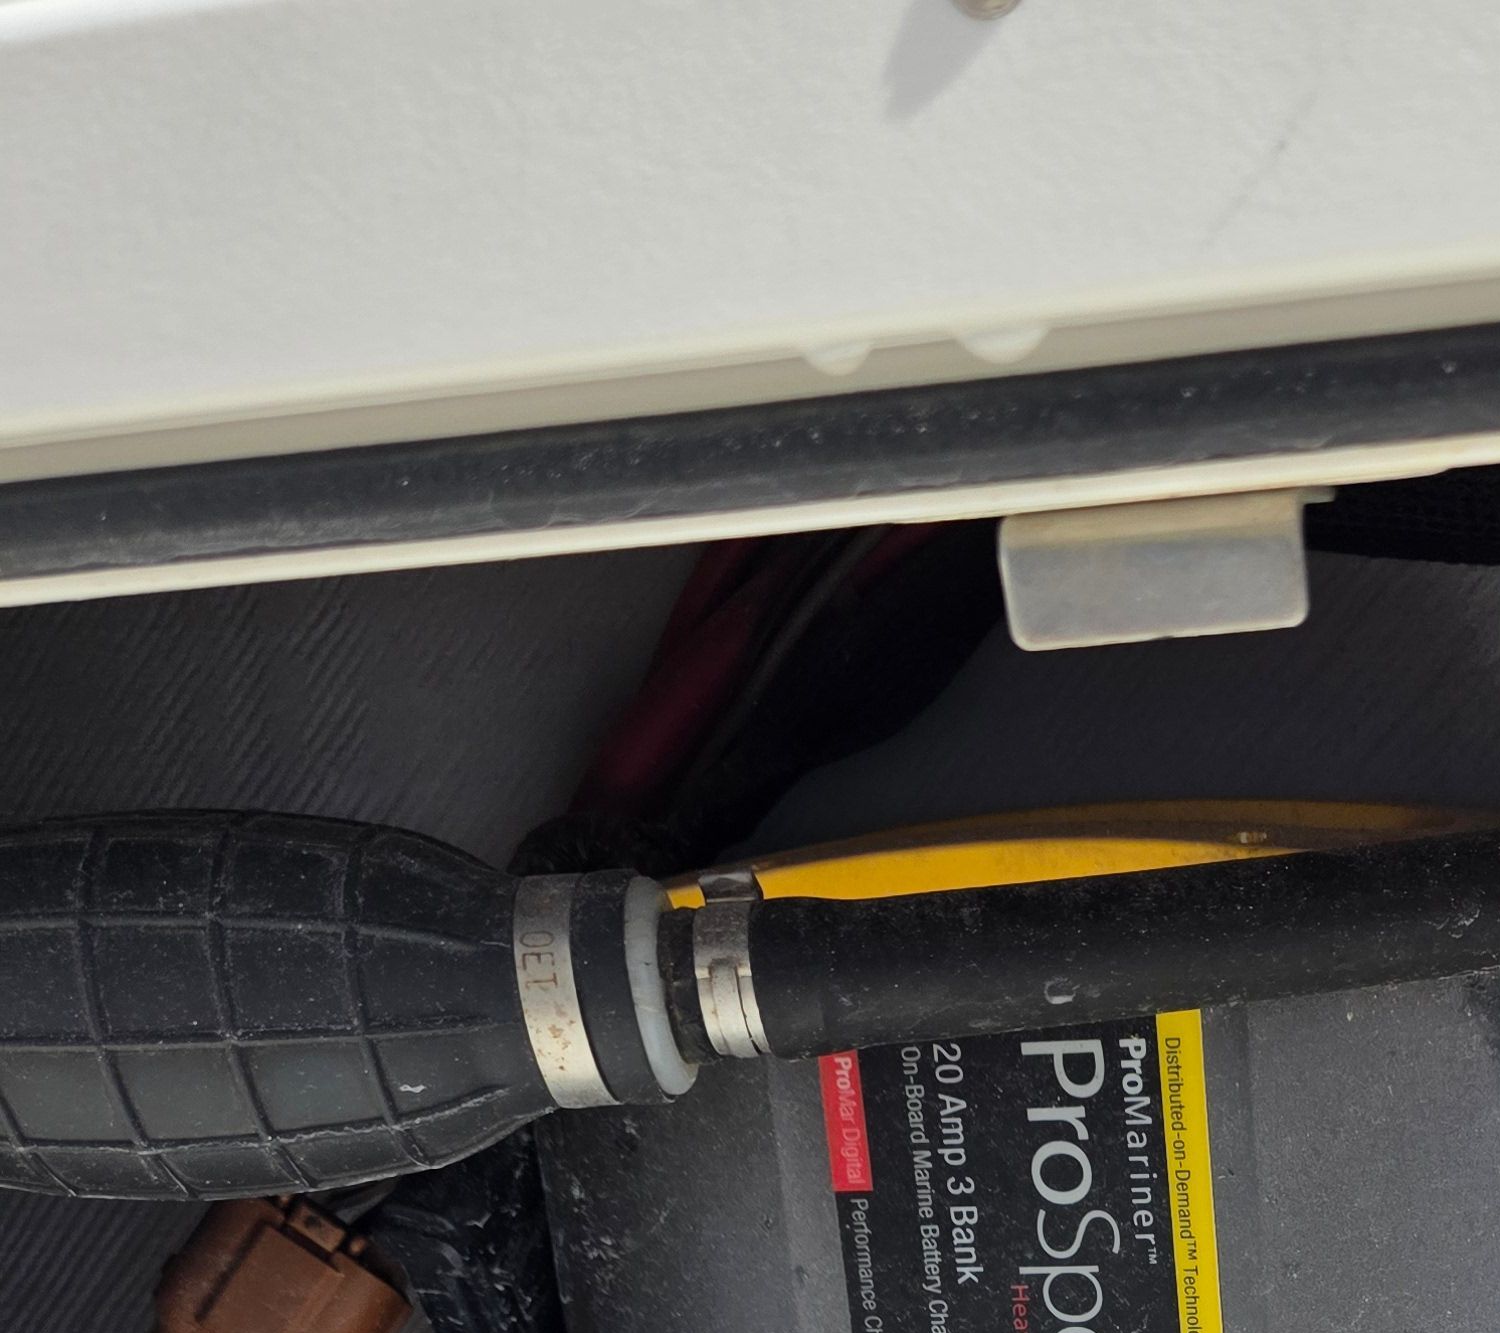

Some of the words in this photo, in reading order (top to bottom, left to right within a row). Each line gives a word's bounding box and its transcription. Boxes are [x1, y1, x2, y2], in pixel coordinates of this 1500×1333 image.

[833, 1056, 856, 1121] ProMar
[900, 1046, 930, 1144] On-Board
[931, 1042, 963, 1084] 20
[838, 1128, 865, 1184] Digital
[932, 1093, 971, 1166] Amp
[911, 1149, 937, 1219] Marine
[944, 1175, 974, 1195] 3
[849, 1199, 879, 1310] Performance
[915, 1224, 945, 1294] Battery
[948, 1204, 985, 1284] Bank
